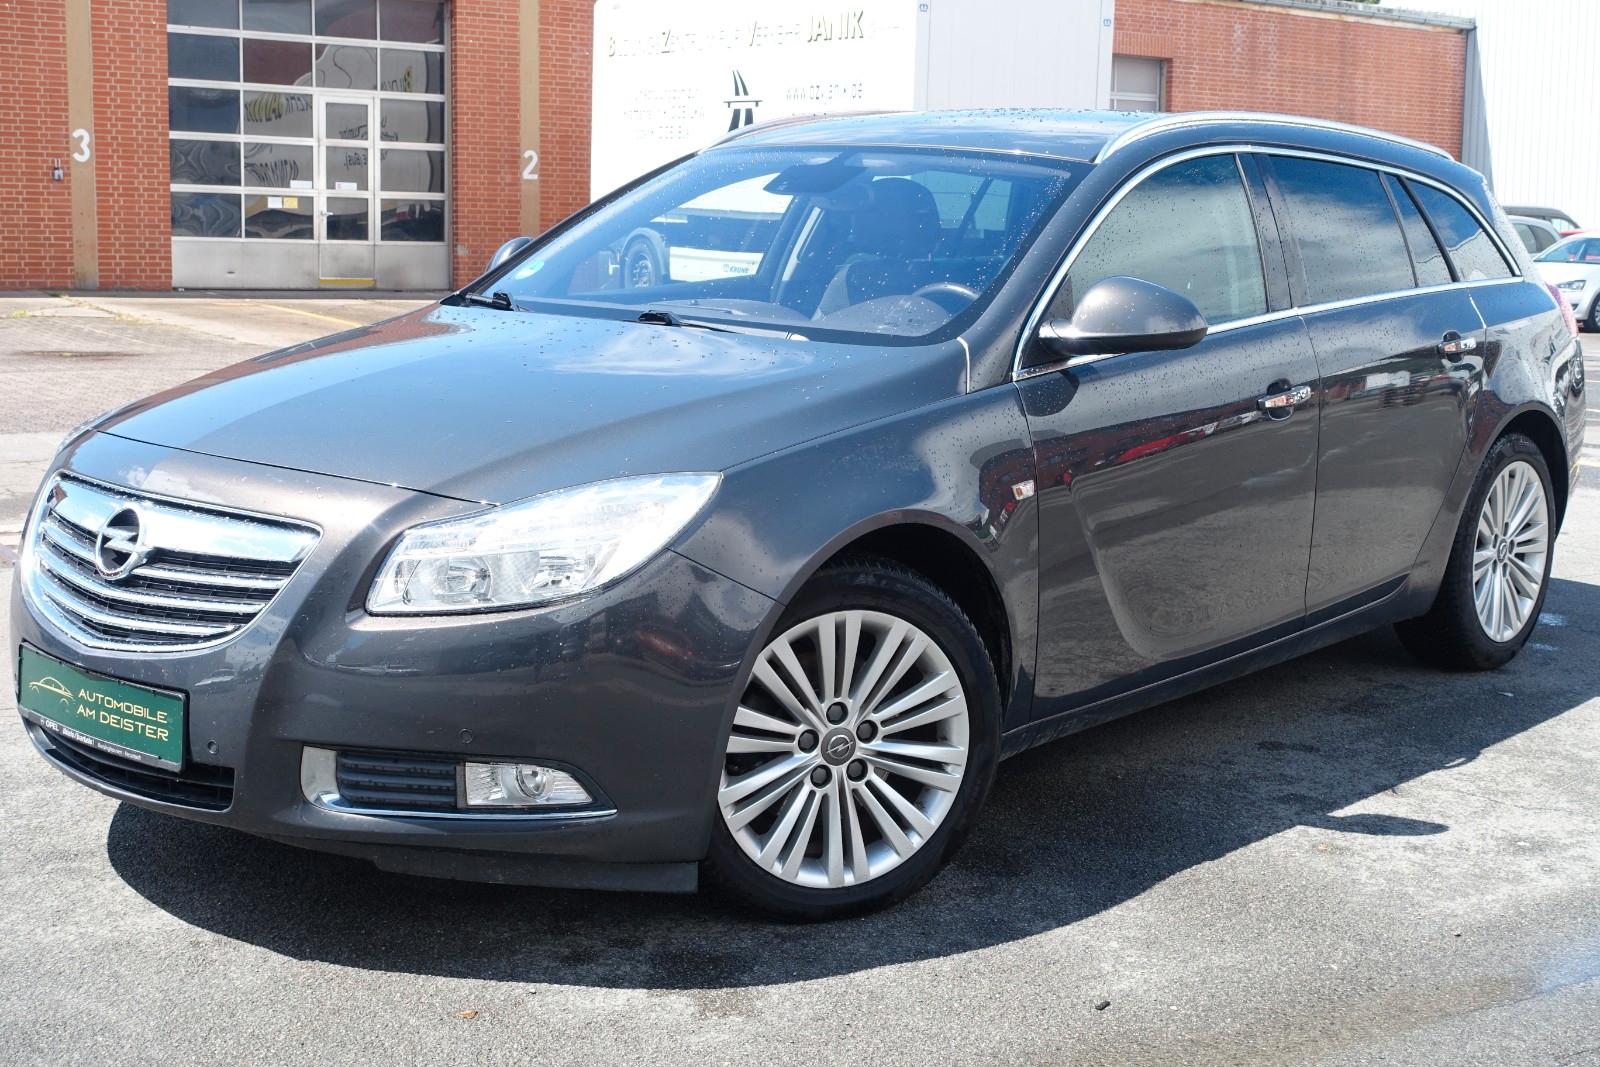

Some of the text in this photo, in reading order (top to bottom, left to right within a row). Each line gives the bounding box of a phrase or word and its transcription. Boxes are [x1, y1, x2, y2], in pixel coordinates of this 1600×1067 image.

[72, 128, 90, 162] 3
[522, 149, 539, 180] 2
[77, 704, 96, 720] AM
[99, 711, 169, 741] DEISTER
[78, 688, 168, 723] AUTOMOBILE
[45, 719, 60, 732] OPEL
